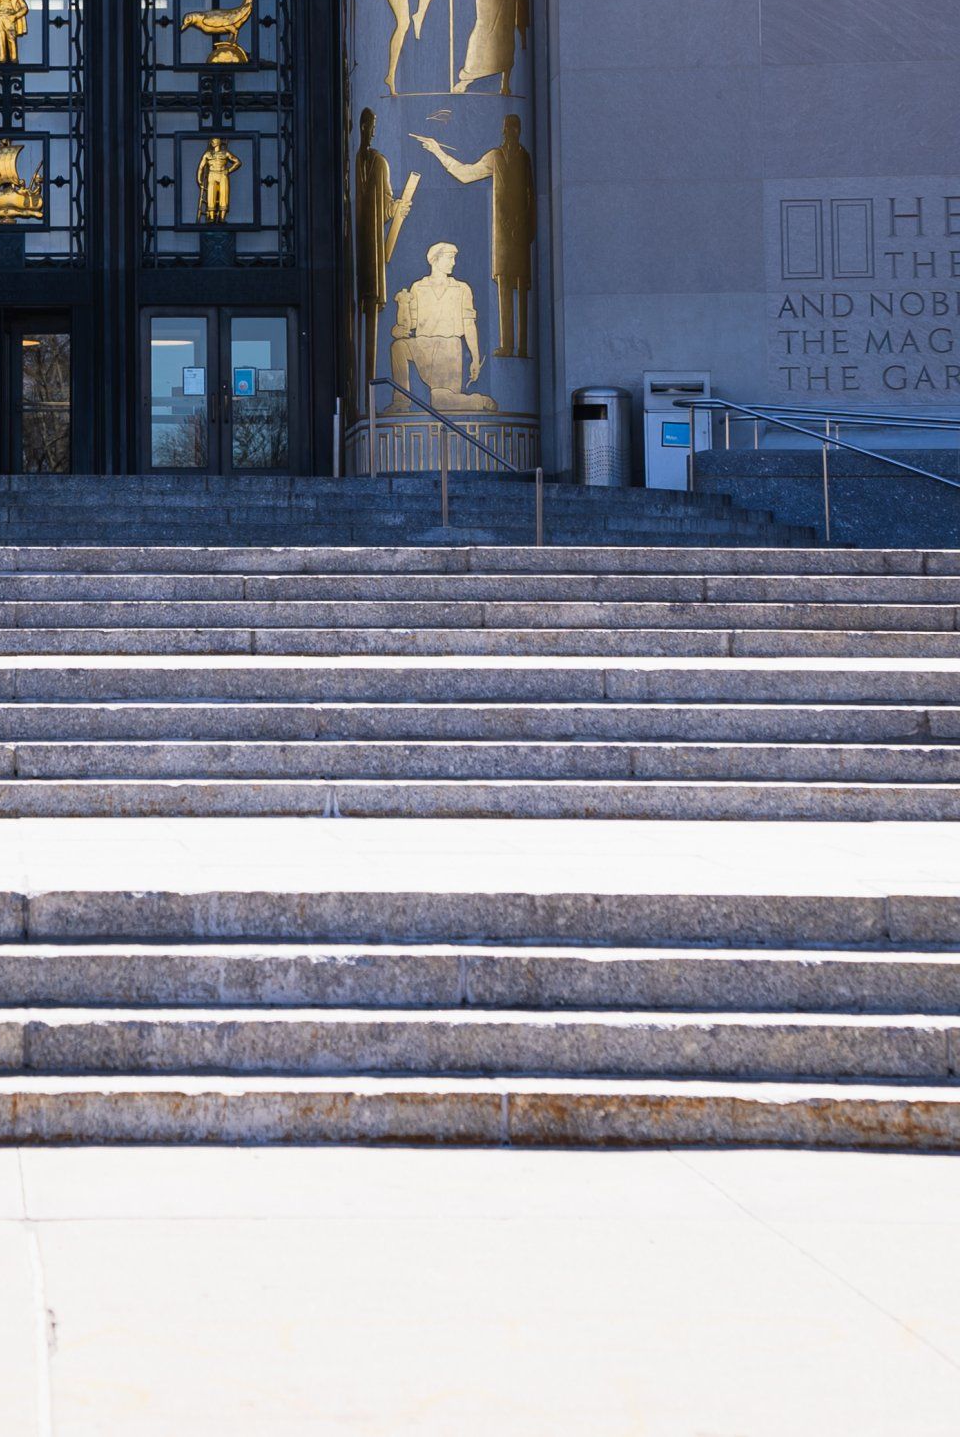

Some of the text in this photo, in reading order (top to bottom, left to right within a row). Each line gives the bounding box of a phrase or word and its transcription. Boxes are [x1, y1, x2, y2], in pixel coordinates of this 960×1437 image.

[777, 293, 854, 319] AND
[778, 327, 954, 354] THE MAG
[779, 365, 860, 391] THE
